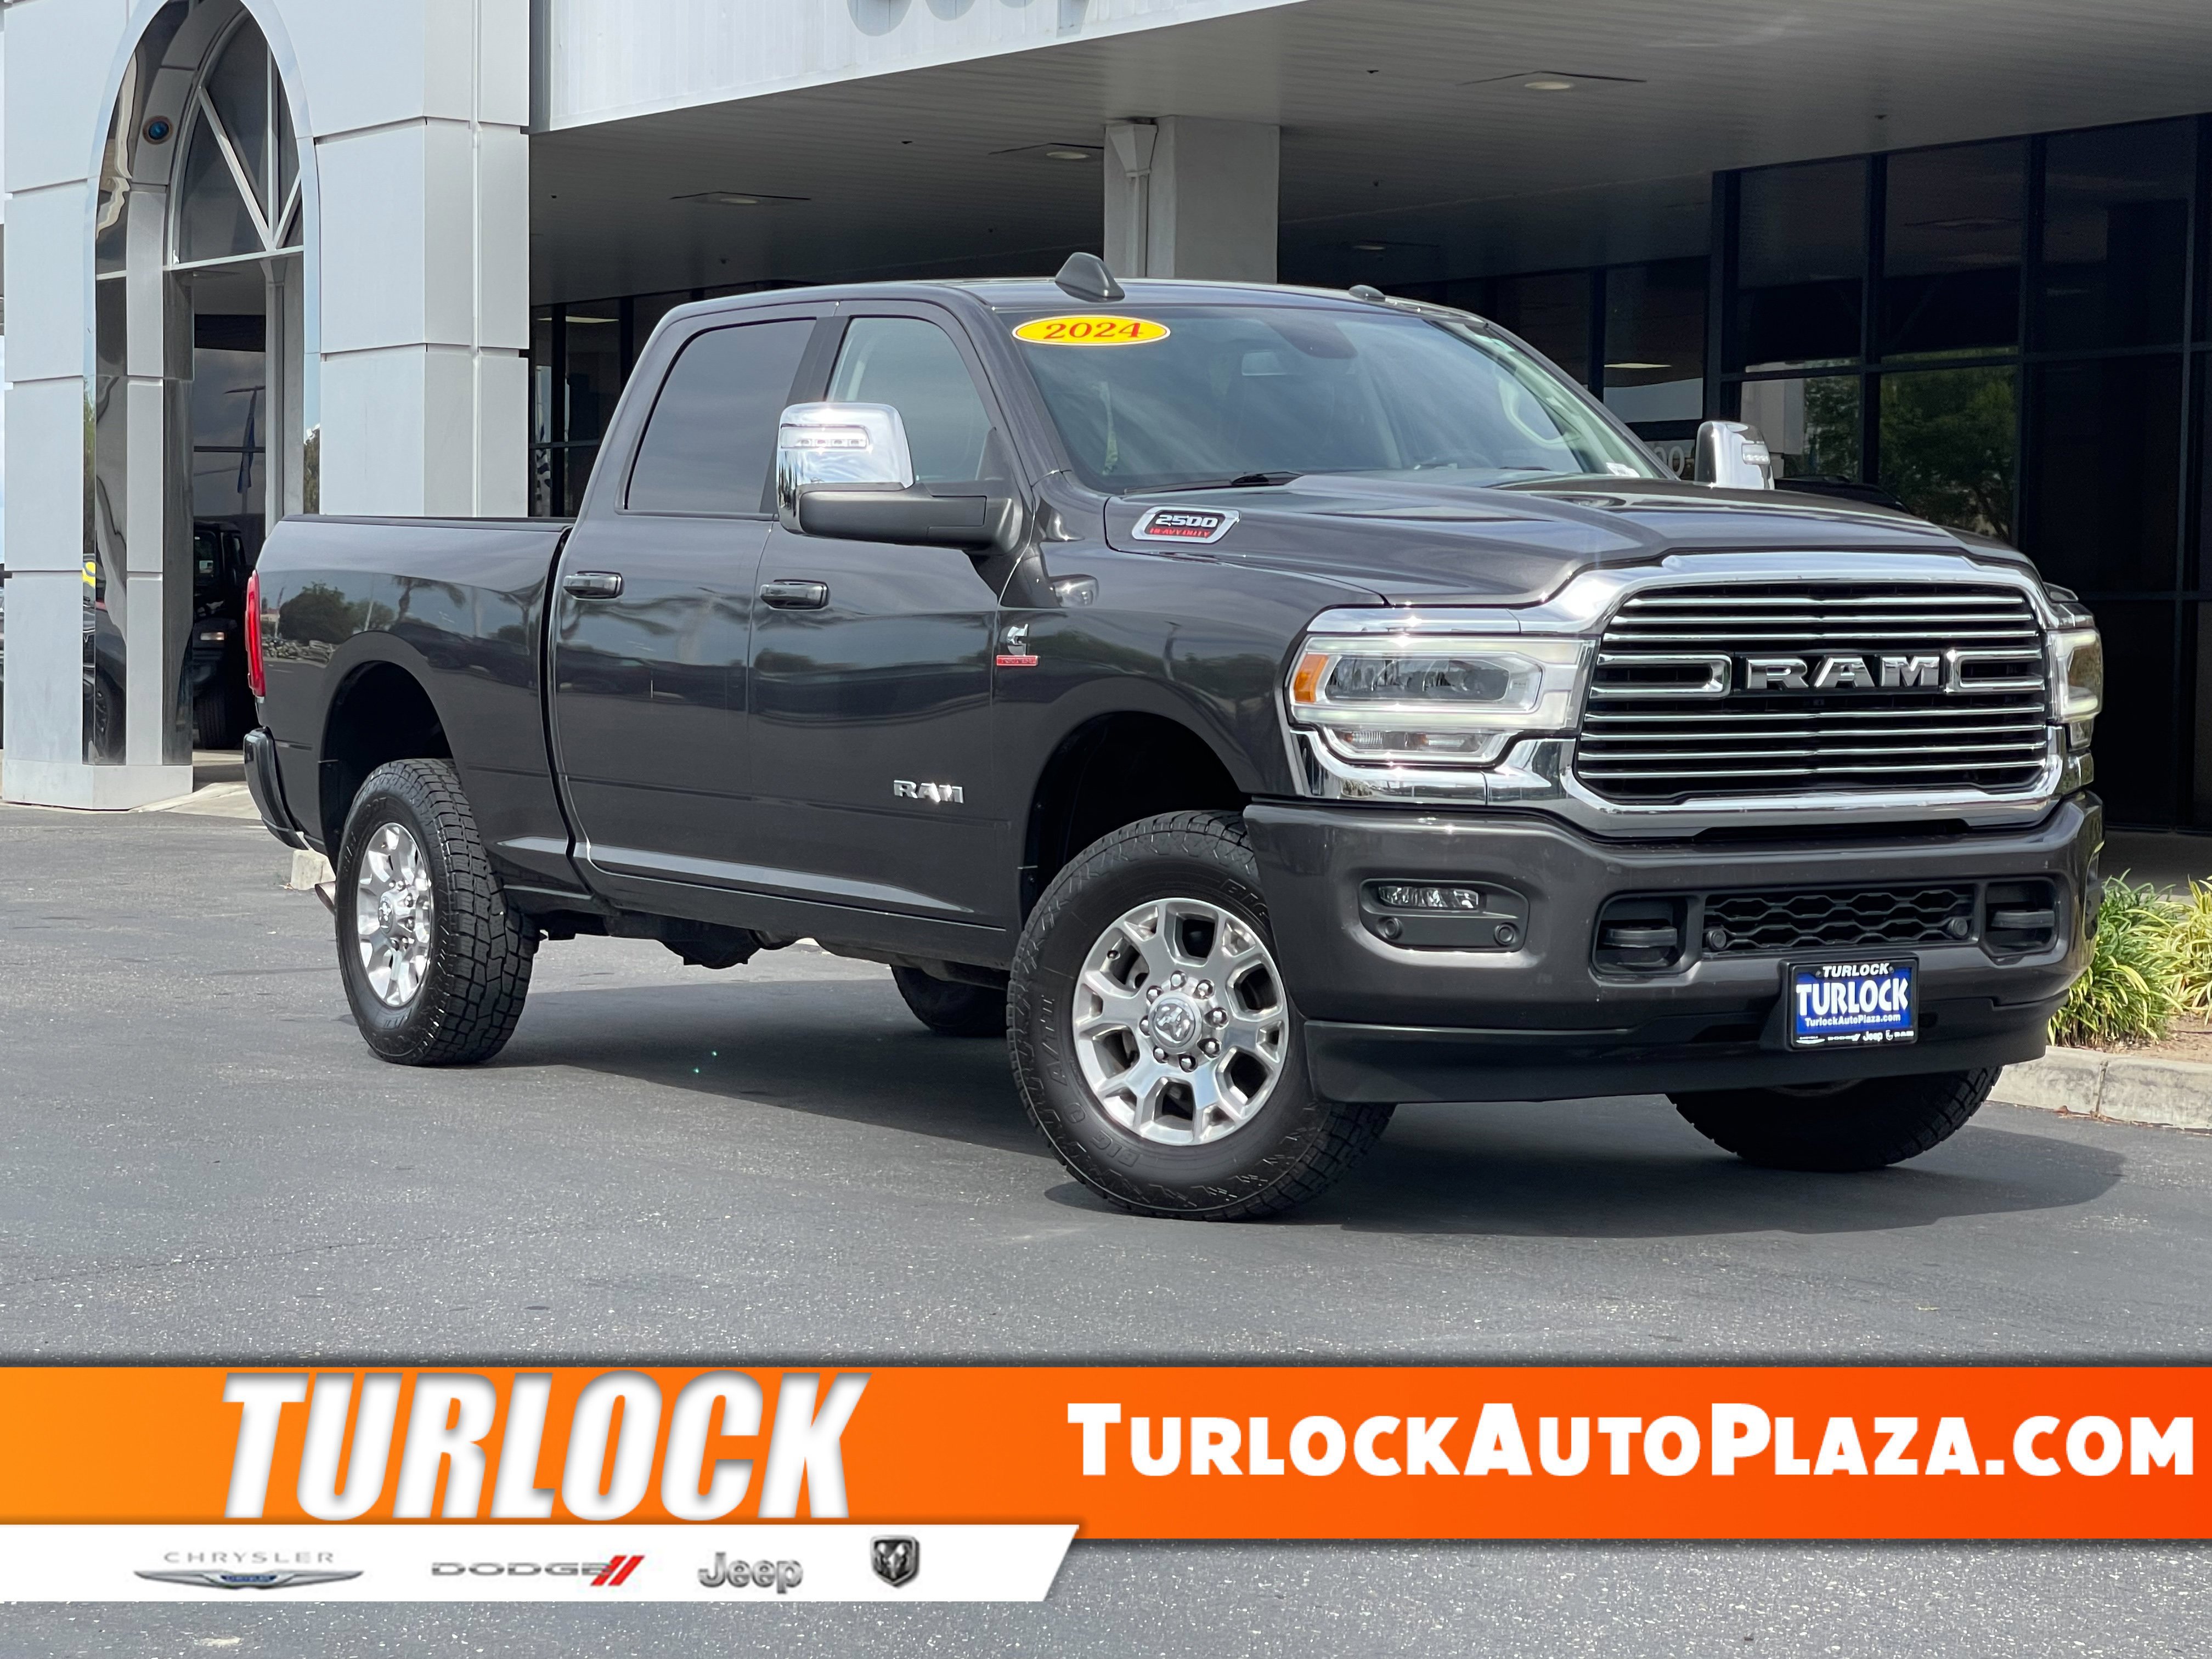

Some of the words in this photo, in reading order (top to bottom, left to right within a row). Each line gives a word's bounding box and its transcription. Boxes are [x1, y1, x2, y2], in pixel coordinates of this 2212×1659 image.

[1043, 322, 1143, 339] 2024
[1155, 515, 1218, 528] 2500
[1746, 654, 1940, 690] RAM
[894, 780, 964, 803] RAM
[1822, 963, 1890, 978] TURLOCK
[1796, 978, 1908, 1016] TURLOCK
[1804, 1014, 1901, 1028] TurlockAutoPlaza.com
